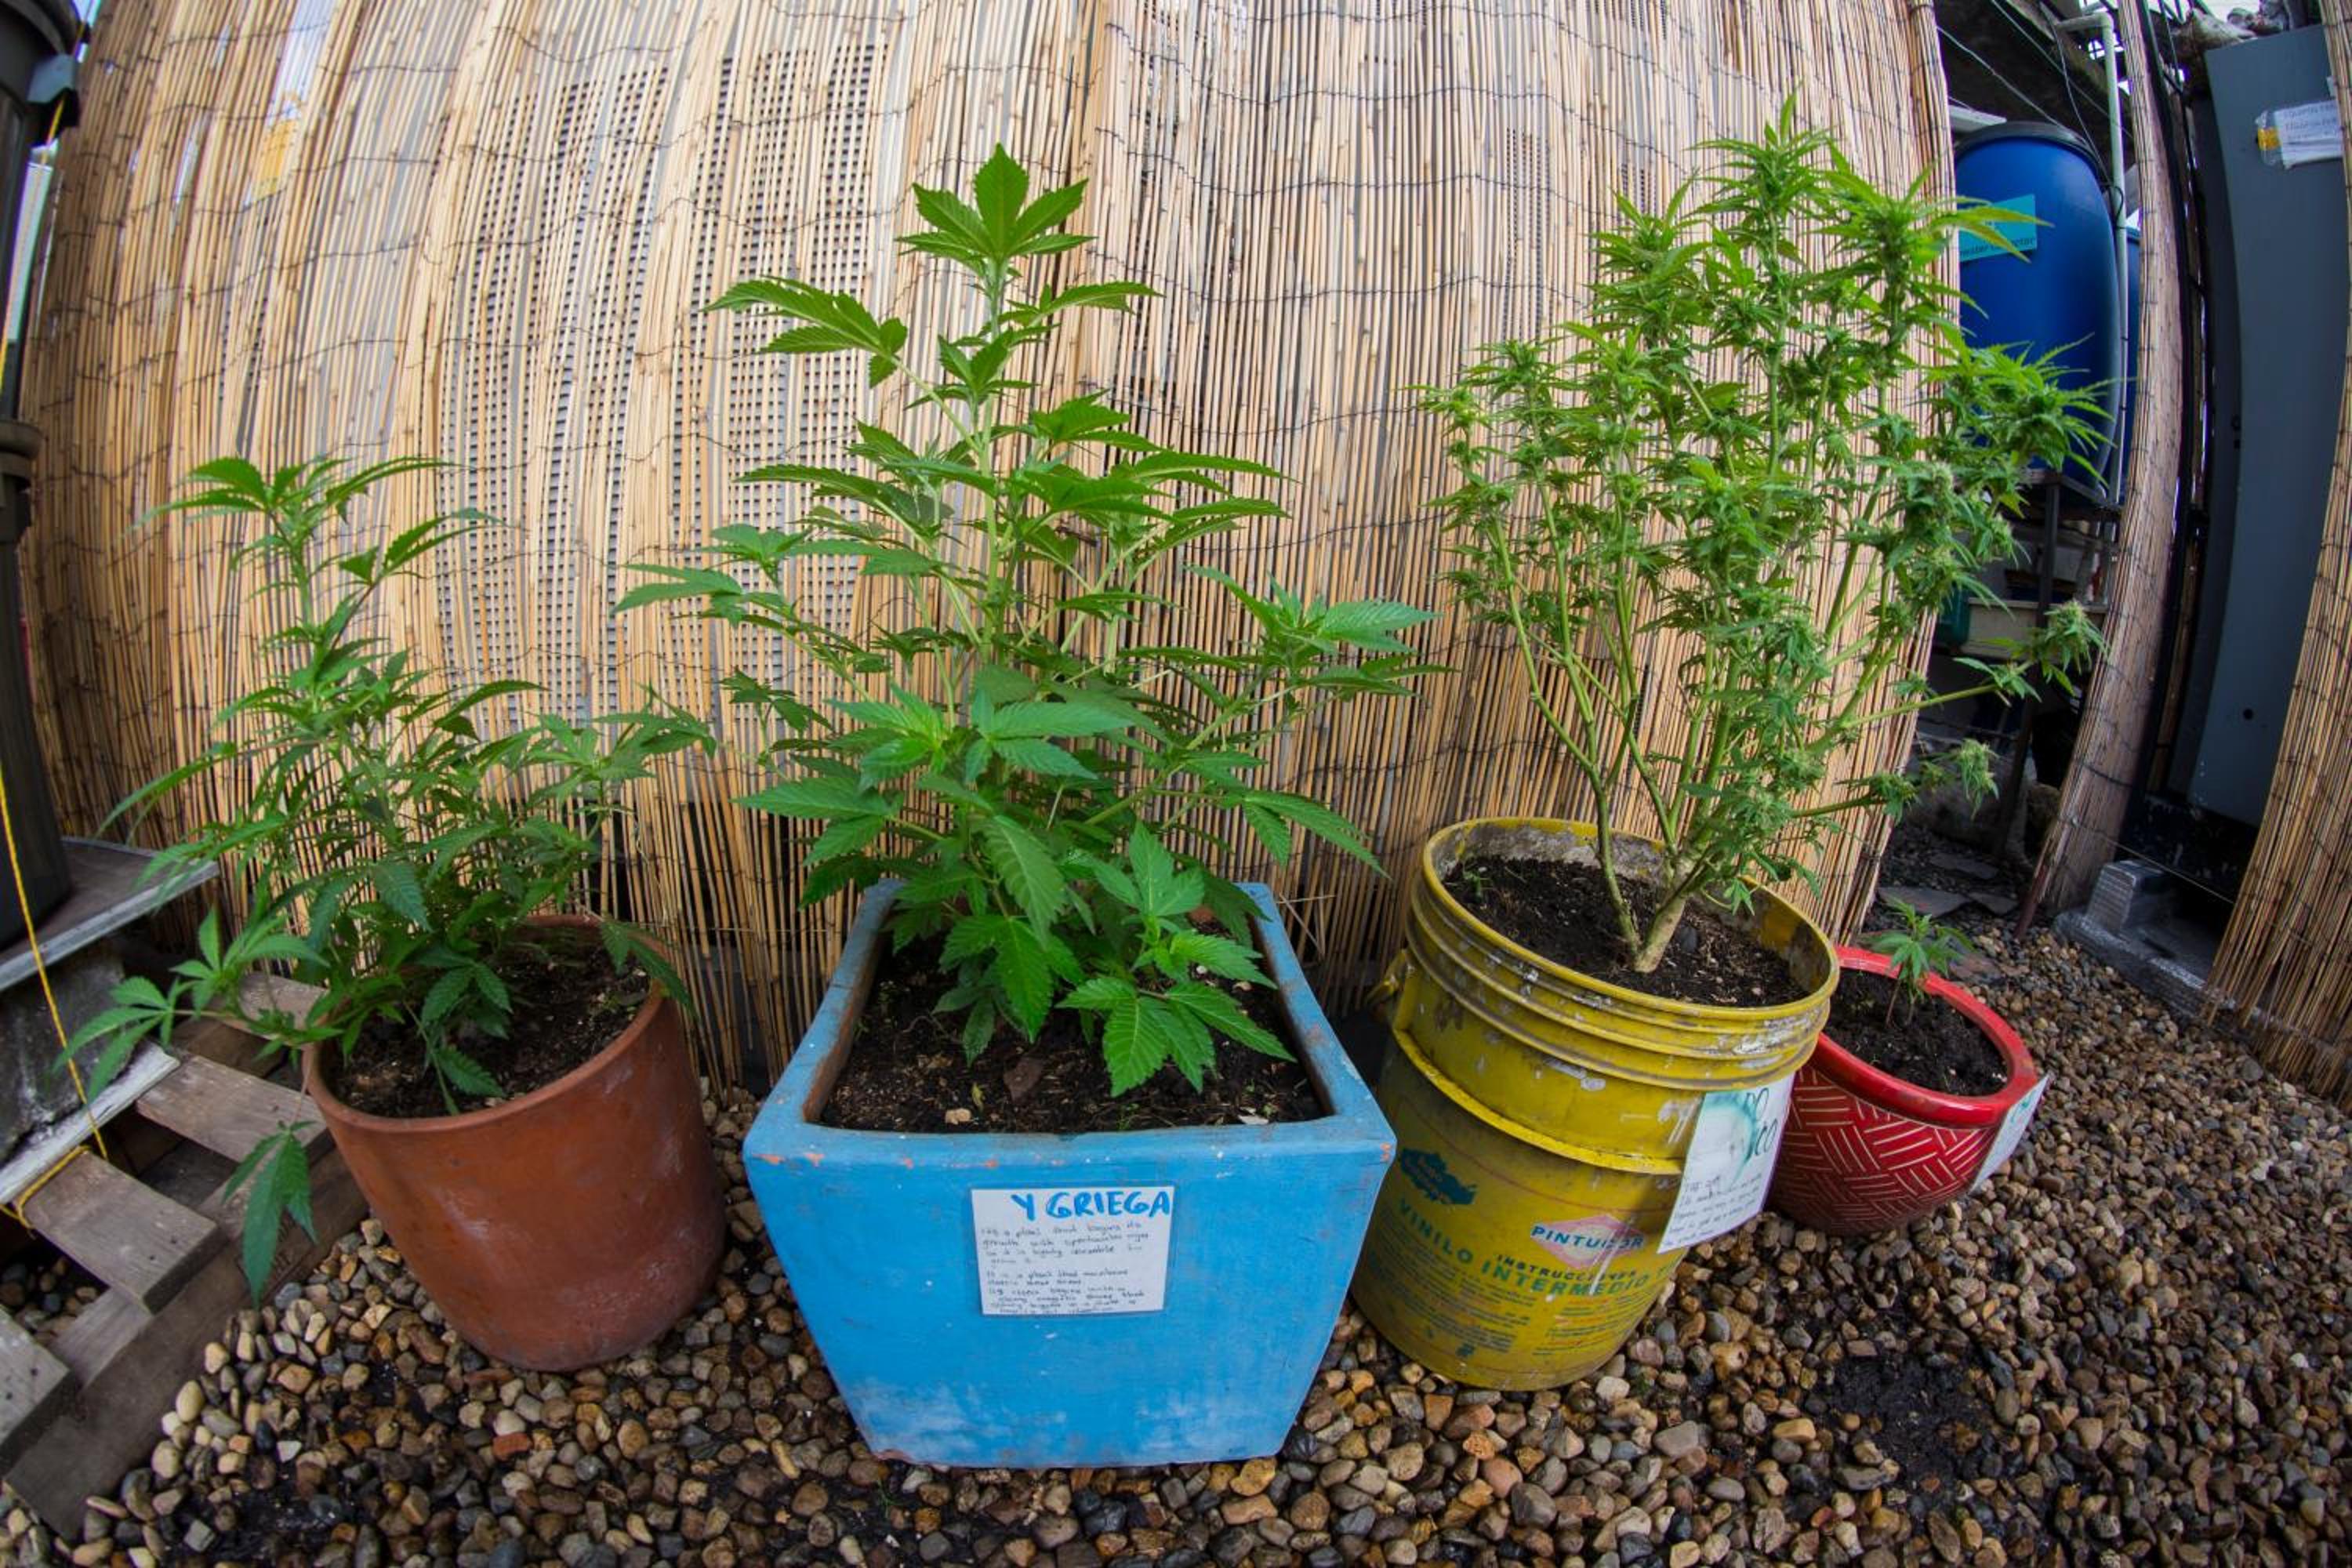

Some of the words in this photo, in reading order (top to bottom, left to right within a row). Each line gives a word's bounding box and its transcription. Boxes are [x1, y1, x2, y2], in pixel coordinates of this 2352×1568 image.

[1011, 1192, 1036, 1221] Y
[1046, 1191, 1171, 1219] GRIEGA
[1400, 1198, 1474, 1265] VINILO
[1481, 1261, 1649, 1296] INTERMEDIO
